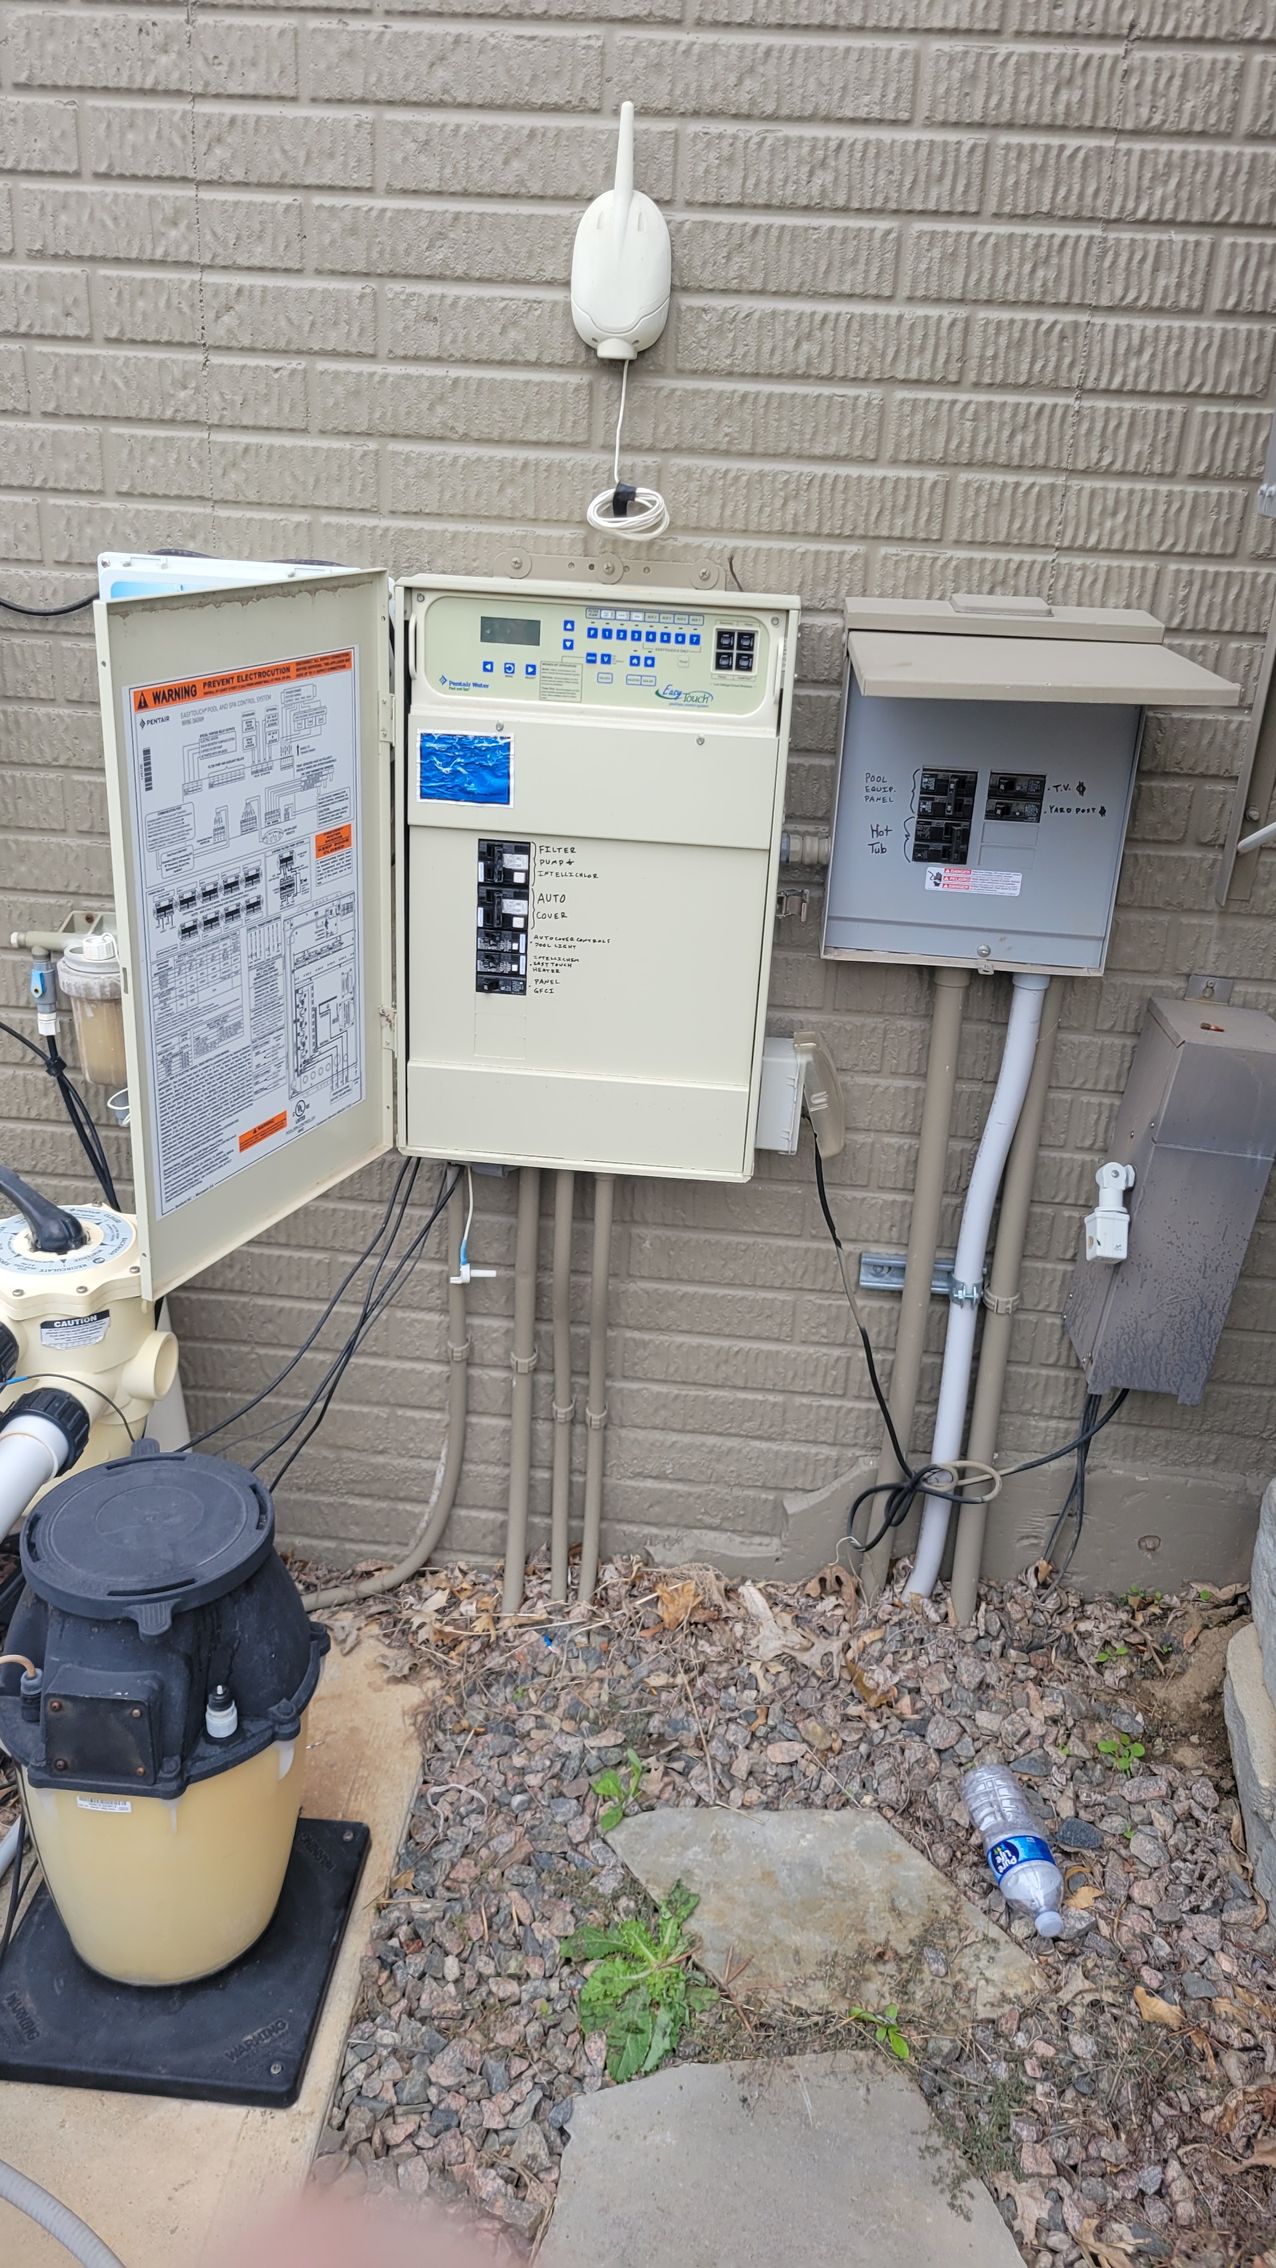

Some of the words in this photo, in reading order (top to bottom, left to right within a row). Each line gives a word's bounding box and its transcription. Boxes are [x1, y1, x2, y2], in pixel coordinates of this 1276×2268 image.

[202, 677, 234, 690] PREVENT
[236, 666, 291, 683] ELECTROCUTION
[449, 680, 471, 688] Pentair
[152, 684, 197, 705] WARNING
[662, 684, 682, 700] Easy
[682, 692, 709, 704] Touch
[207, 705, 218, 713] POOL
[219, 702, 229, 710] AND
[237, 697, 255, 708] CONTROL
[256, 693, 272, 702] SYSTEM
[146, 715, 170, 726] PENTAIR
[865, 772, 888, 784] POOL
[864, 785, 896, 793] EQUIP.
[1052, 783, 1071, 793] T.V.
[864, 795, 895, 803] PANEL
[1049, 804, 1072, 814] YARD
[870, 823, 893, 838] Hot
[538, 845, 576, 854] FILTER
[867, 841, 887, 854] Tub
[537, 893, 567, 904] AUTO
[536, 911, 568, 920] COVER
[39, 1264, 88, 1273] RECIRCULATE
[53, 1314, 98, 1328] CAUTION
[995, 1849, 1012, 1864] Life
[997, 1855, 1018, 1873] Pure
[223, 2019, 290, 2065] WARNING
